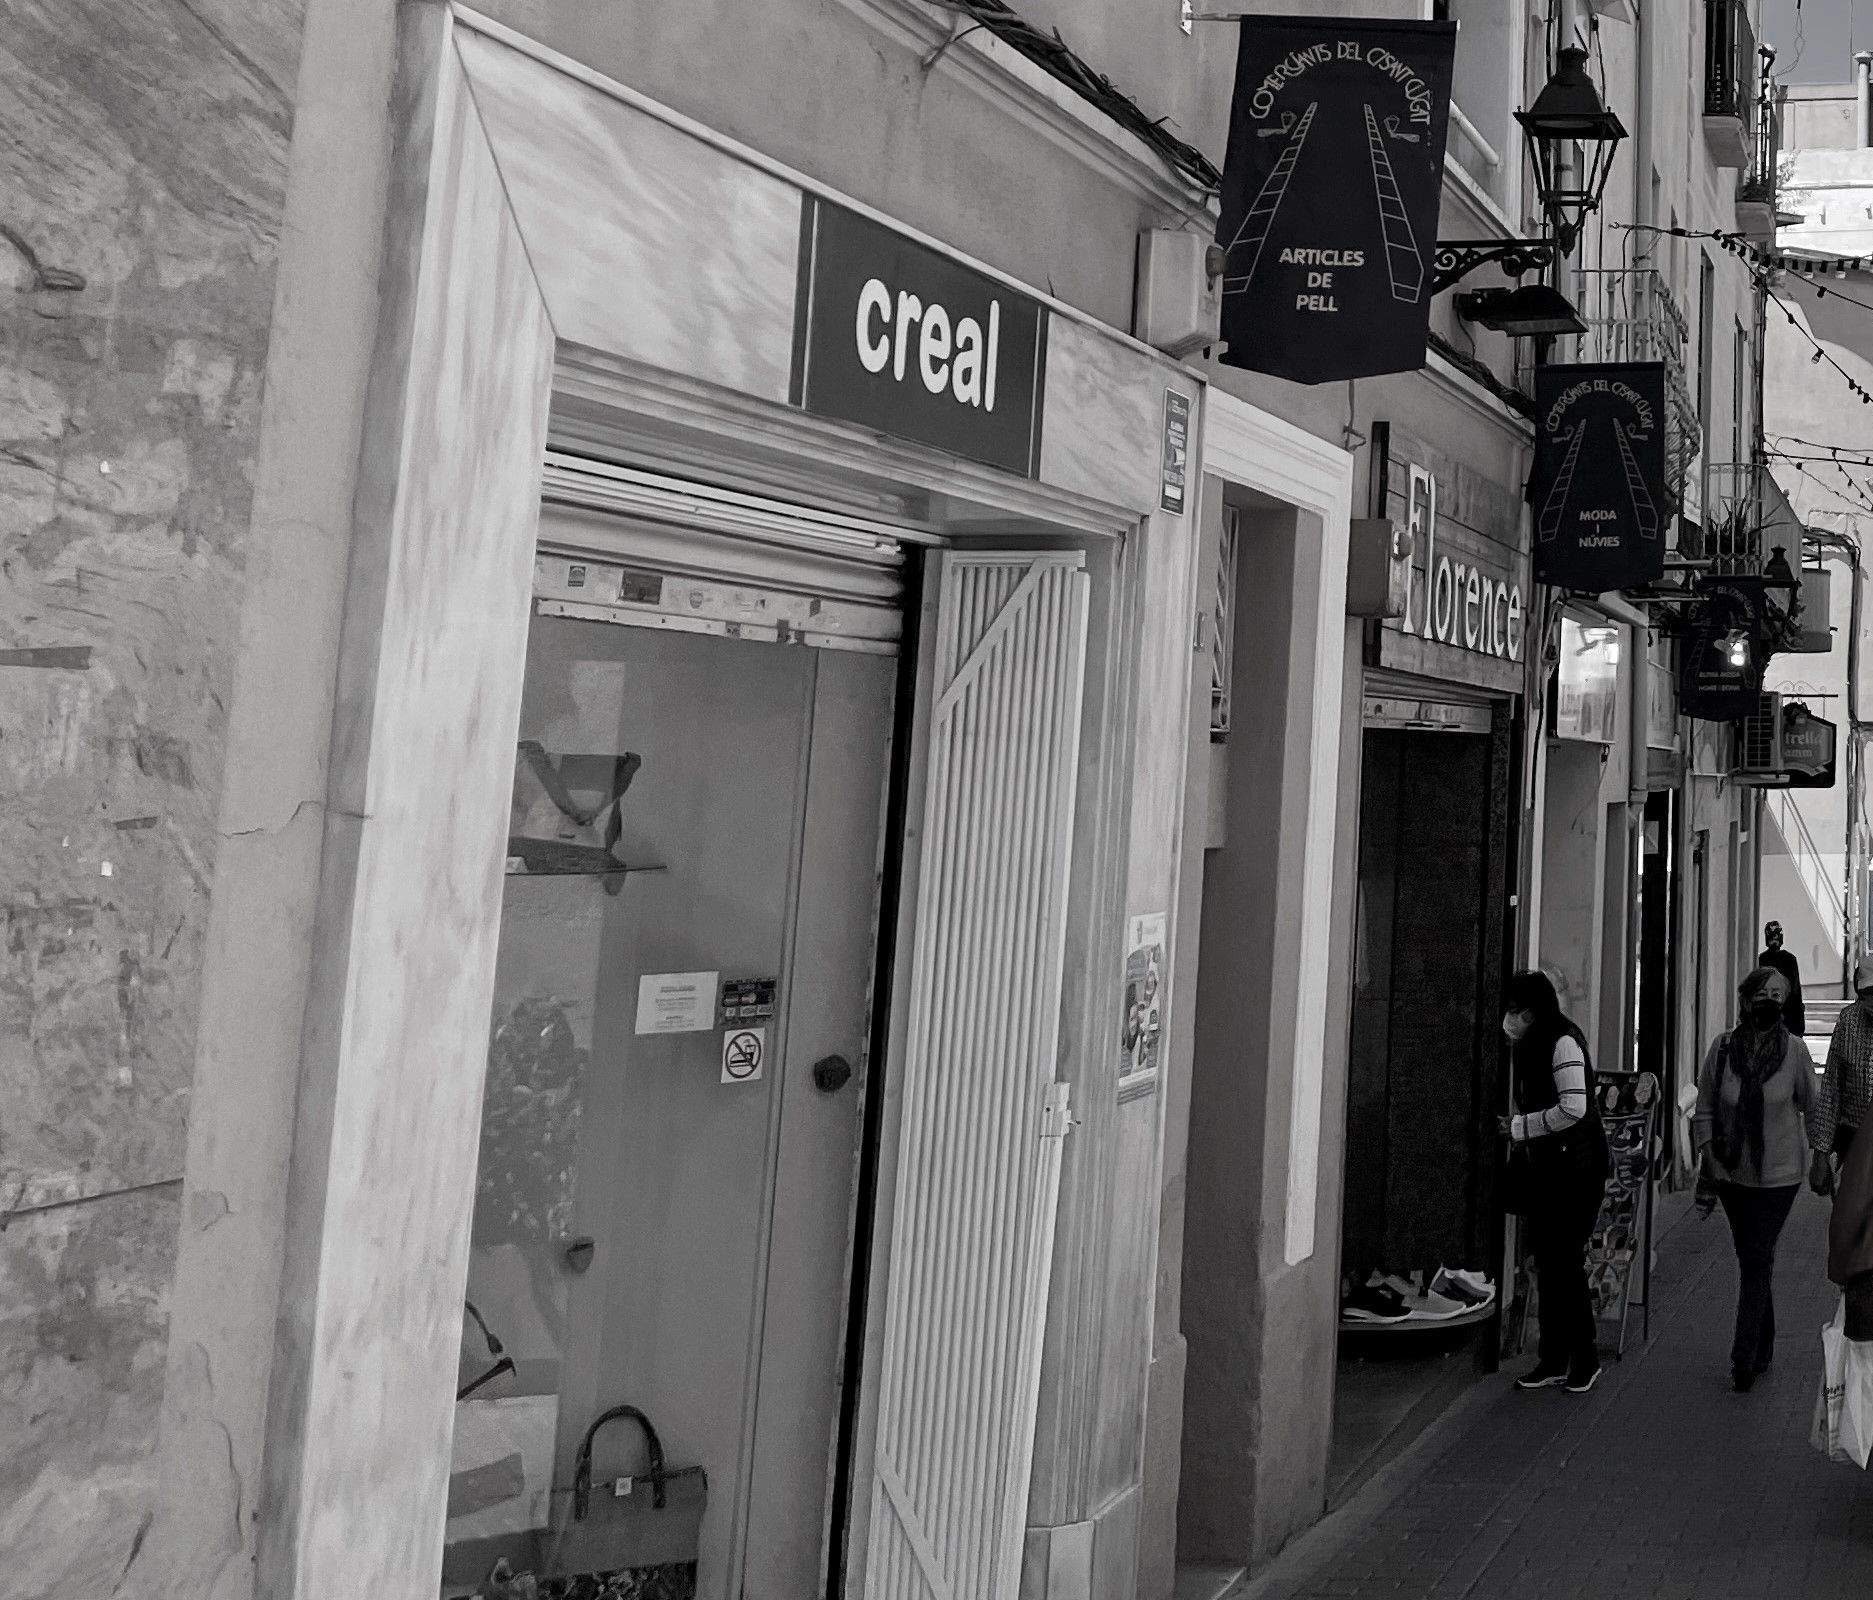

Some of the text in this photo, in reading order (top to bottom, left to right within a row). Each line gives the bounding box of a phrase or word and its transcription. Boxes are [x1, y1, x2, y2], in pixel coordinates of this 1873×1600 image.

[1337, 41, 1362, 61] DEL
[1405, 78, 1432, 125] CUGAT
[1279, 247, 1365, 267] ARTICLES
[1307, 272, 1334, 288] DE
[1296, 294, 1338, 312] PELL
[856, 278, 1000, 413] creal
[1594, 379, 1611, 392] DEL
[1579, 510, 1617, 521] MODA
[1402, 462, 1521, 661] Florence
